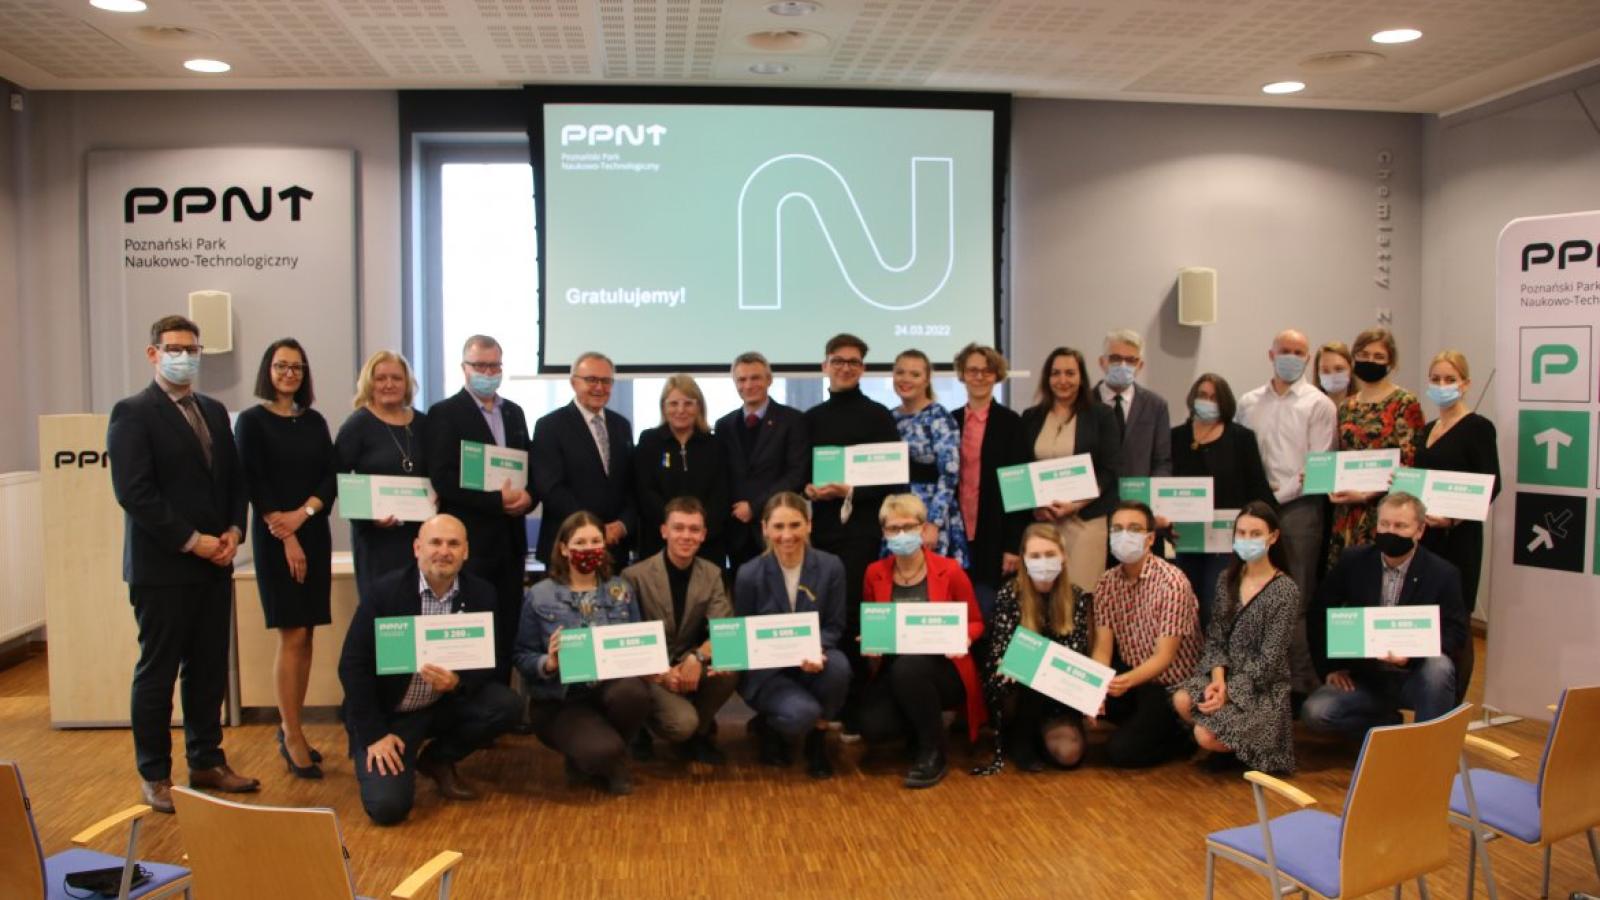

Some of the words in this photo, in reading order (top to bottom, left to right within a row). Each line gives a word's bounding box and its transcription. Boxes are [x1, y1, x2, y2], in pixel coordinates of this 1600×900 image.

[561, 124, 667, 146] PPNT
[124, 185, 314, 223] PPNT
[125, 237, 192, 251] Poznański
[196, 237, 226, 251] Park
[125, 253, 299, 270] Naukowo-Technologiczny
[1521, 239, 1600, 272] PP
[565, 287, 686, 308] Gratulujemy!
[1520, 282, 1574, 294] Poznański
[1576, 280, 1600, 292] Park
